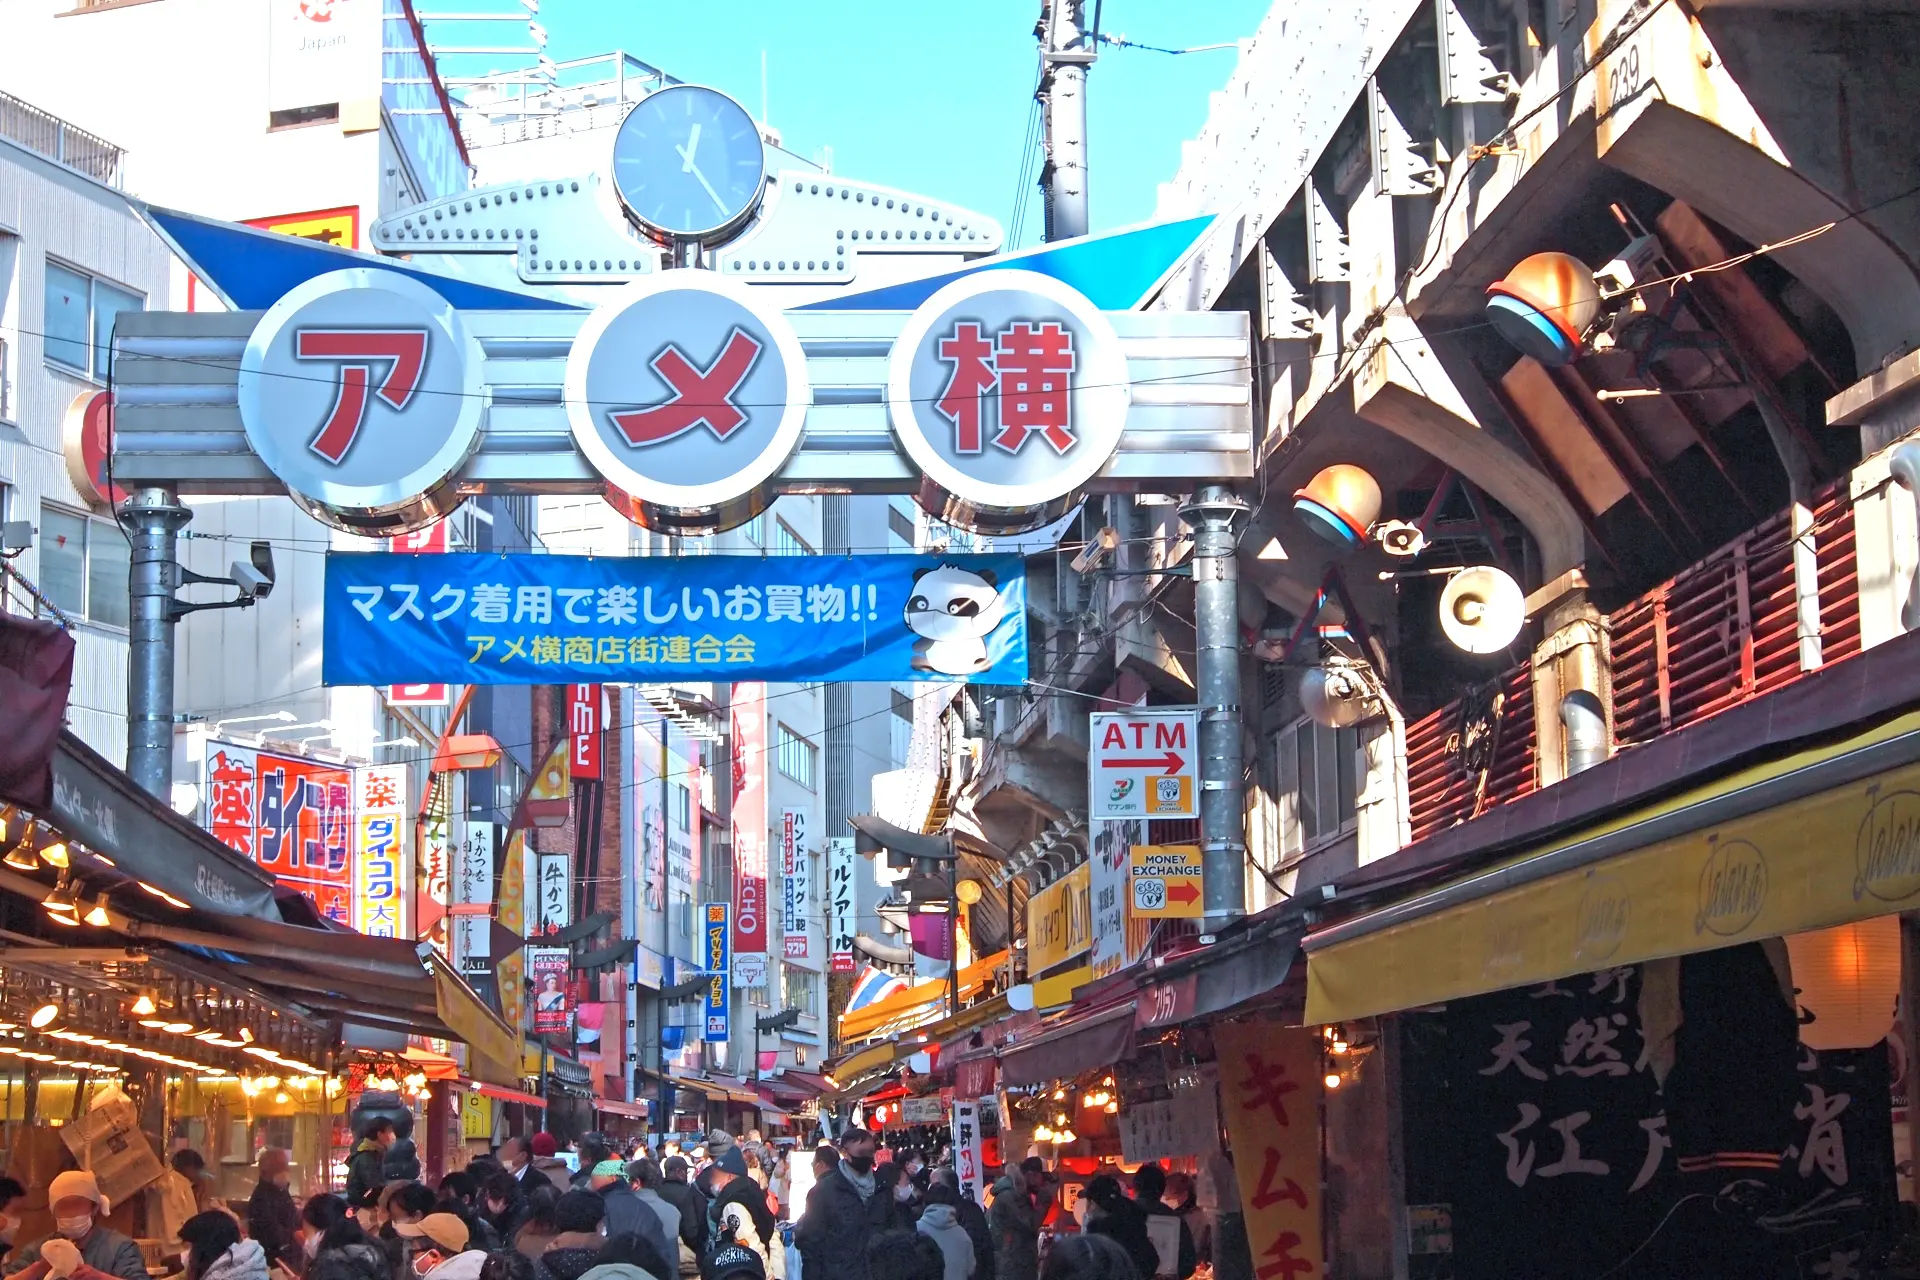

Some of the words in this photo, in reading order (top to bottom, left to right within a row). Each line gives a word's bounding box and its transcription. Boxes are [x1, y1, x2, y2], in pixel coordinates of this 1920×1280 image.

[299, 34, 347, 50] Japan
[1610, 44, 1639, 105] 239
[296, 321, 1078, 466] アメ横
[346, 583, 879, 626] マスク着用で楽しいお買物!!
[467, 634, 756, 664] アメ横商店街連合会
[1101, 722, 1187, 749] ATM
[207, 750, 254, 857] 薬
[260, 766, 349, 873] ダイコク
[365, 772, 397, 808] 薬
[367, 818, 394, 900] ダイコク
[473, 829, 487, 883] 牛かつを
[1132, 865, 1201, 875] EXCHANGE
[1145, 855, 1187, 864] MONEY
[545, 862, 565, 915] 牛かつ
[738, 876, 757, 934] ECHO
[834, 864, 853, 951] ルノアール
[708, 907, 725, 923] 薬
[1238, 1053, 1314, 1280] キムチ
[715, 1249, 751, 1266] DICKIES
